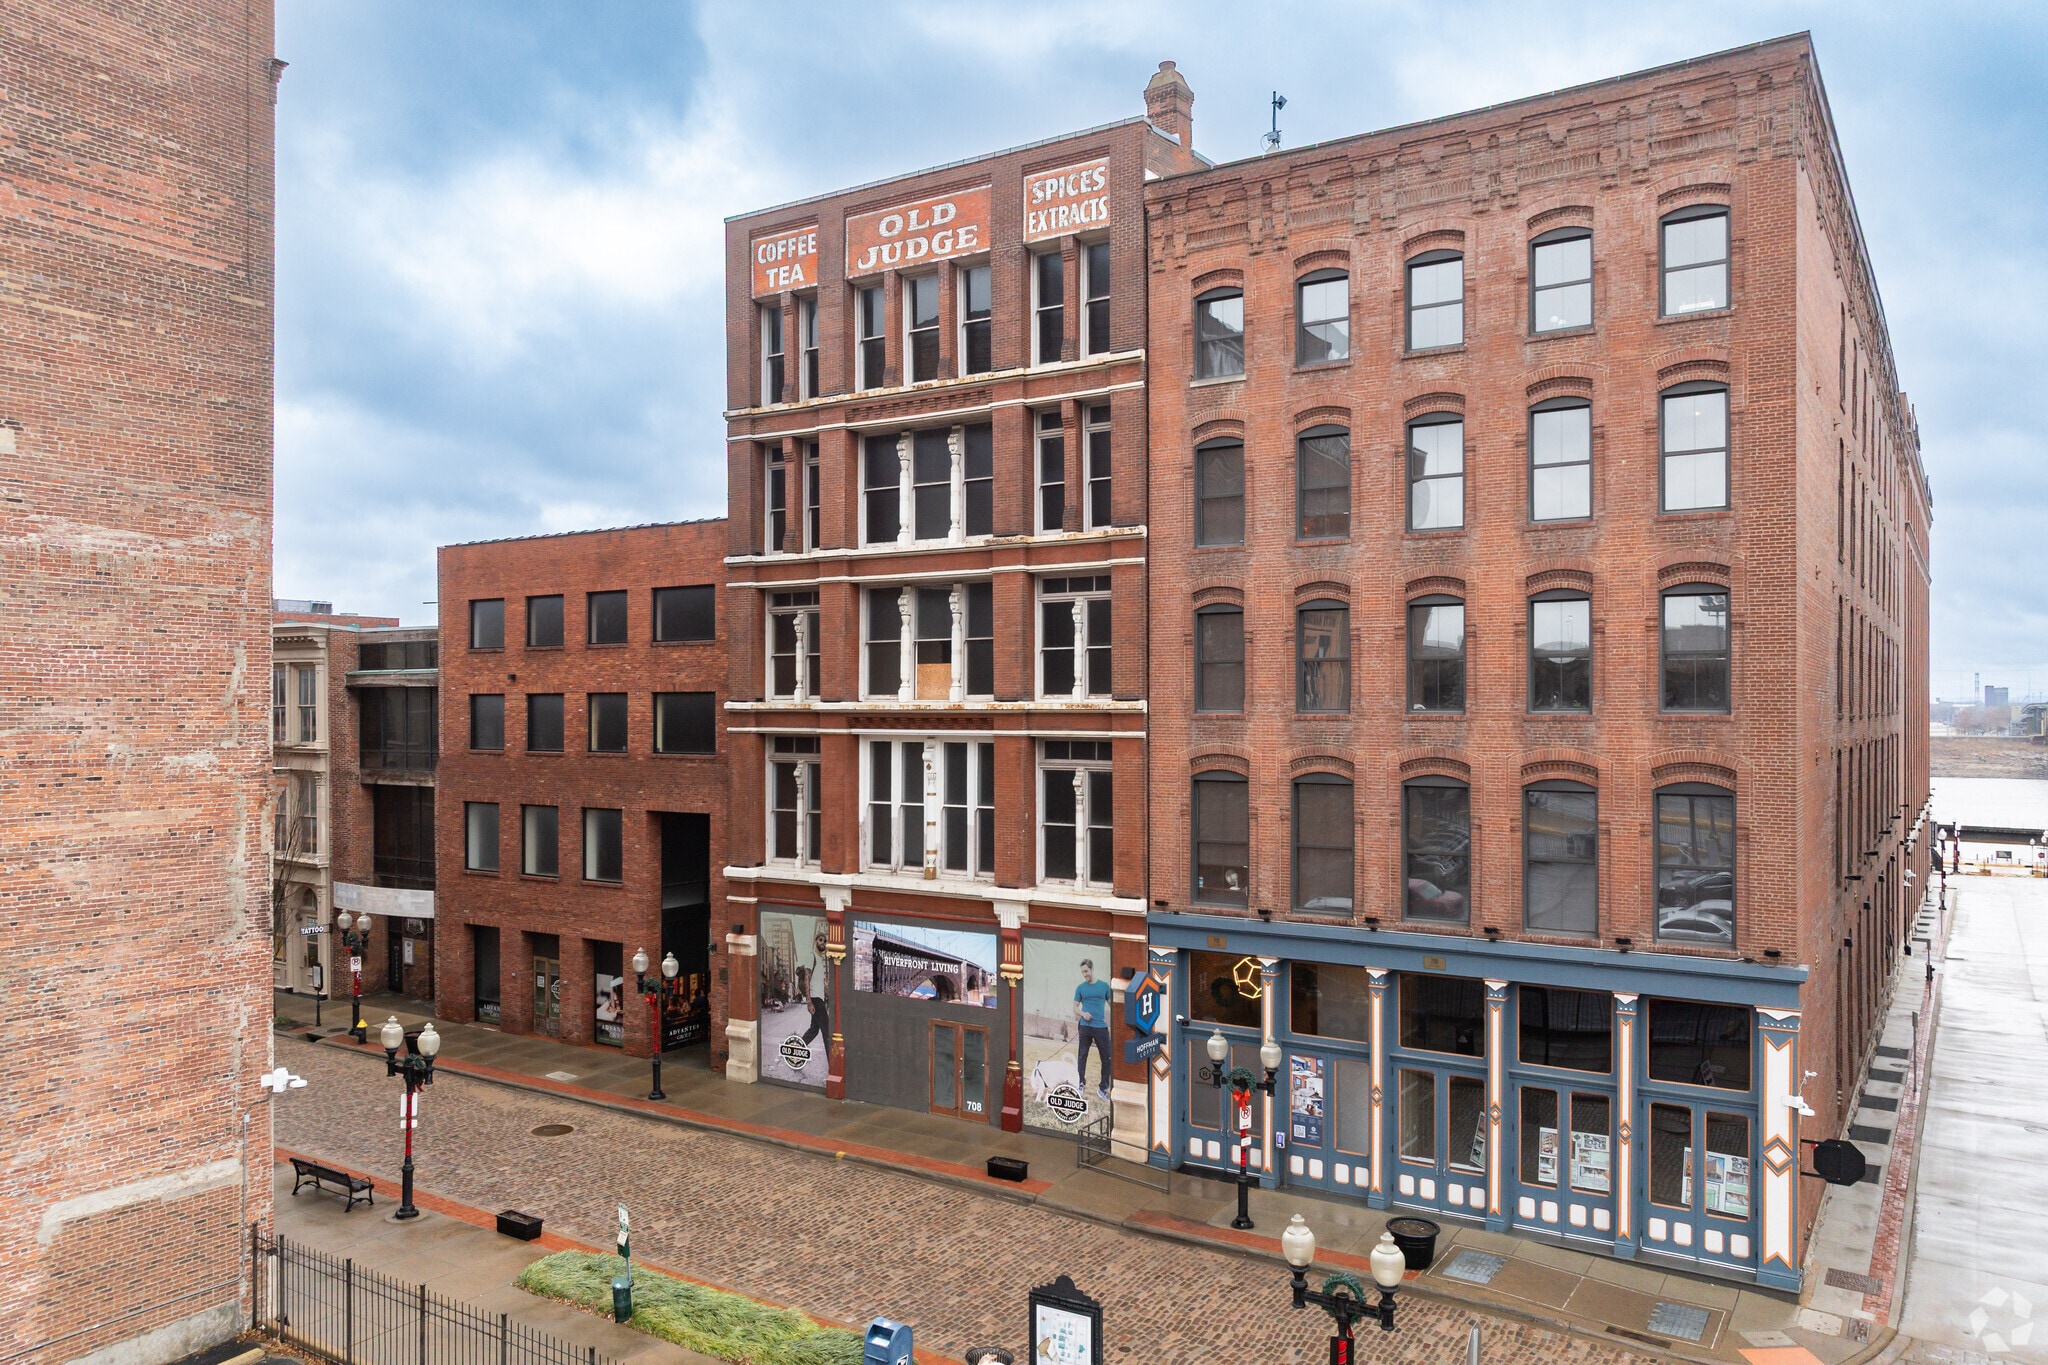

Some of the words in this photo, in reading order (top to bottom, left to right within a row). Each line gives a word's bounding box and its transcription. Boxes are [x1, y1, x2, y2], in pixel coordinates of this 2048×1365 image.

[1032, 165, 1106, 205] SPICES
[878, 201, 957, 238] OLD
[1028, 194, 1109, 235] EXTRACTS
[757, 233, 817, 265] COFFEE
[857, 224, 979, 270] JUDGE
[766, 264, 804, 289] TEA
[301, 926, 324, 935] TATTOO
[884, 956, 929, 970] RIVERFRONT
[931, 962, 959, 974] LIVING
[1142, 992, 1153, 1016] H
[781, 1046, 792, 1055] OLD
[792, 1048, 809, 1058] JUDGE
[1136, 1038, 1159, 1053] HOFFMAN
[966, 1101, 982, 1112] 708
[1050, 1097, 1063, 1106] OLD
[1064, 1099, 1084, 1110] JUDGE
